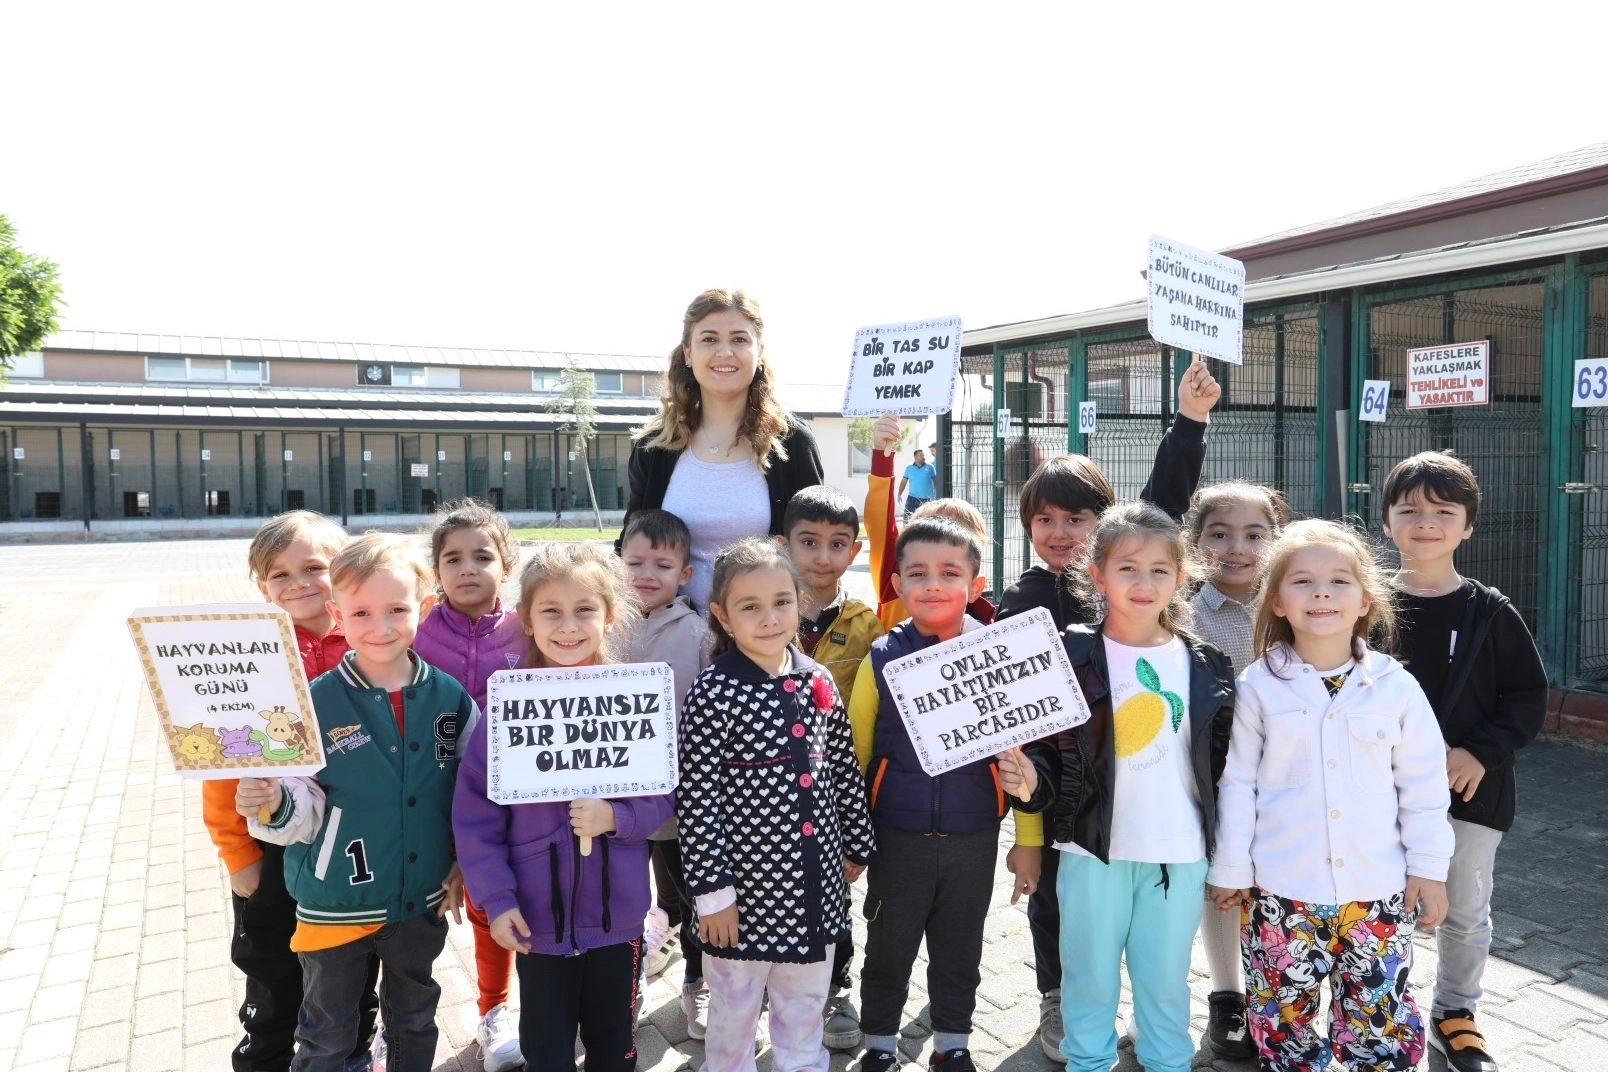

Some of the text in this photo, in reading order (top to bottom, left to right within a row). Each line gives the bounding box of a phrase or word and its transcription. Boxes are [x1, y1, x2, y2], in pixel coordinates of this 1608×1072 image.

[1155, 255, 1239, 297] BÜTÜN CANLILAR
[1195, 296, 1237, 320] HAKKINA
[863, 335, 950, 356] BİR TAS SU
[1413, 346, 1480, 363] KAFESLERE
[873, 357, 934, 377] BİR KAP
[1412, 359, 1482, 376] YAKLAŞMAK
[875, 384, 922, 399] YEMEK
[1410, 375, 1484, 393] TEHLİKELİ ve
[1577, 365, 1608, 400] 63
[1363, 386, 1386, 414] 64
[1419, 390, 1475, 405] YASAKTIR
[998, 413, 1010, 433] 67
[1080, 406, 1095, 428] 66
[156, 641, 279, 658] HAYVANLARI
[177, 661, 259, 677] KORUMA
[940, 644, 1013, 681] ONLAR
[194, 679, 249, 696] GÜNÜ
[913, 650, 1054, 715] HAYATIMIZIN
[206, 702, 255, 714] (4 EKİM)
[502, 693, 660, 722] HAYVANSIZ
[972, 690, 1011, 716] BİR
[508, 718, 657, 748] BIR DÜNYA
[535, 746, 630, 773] OLMAZ
[1128, 743, 1169, 771] lemonade
[345, 838, 375, 886] 1
